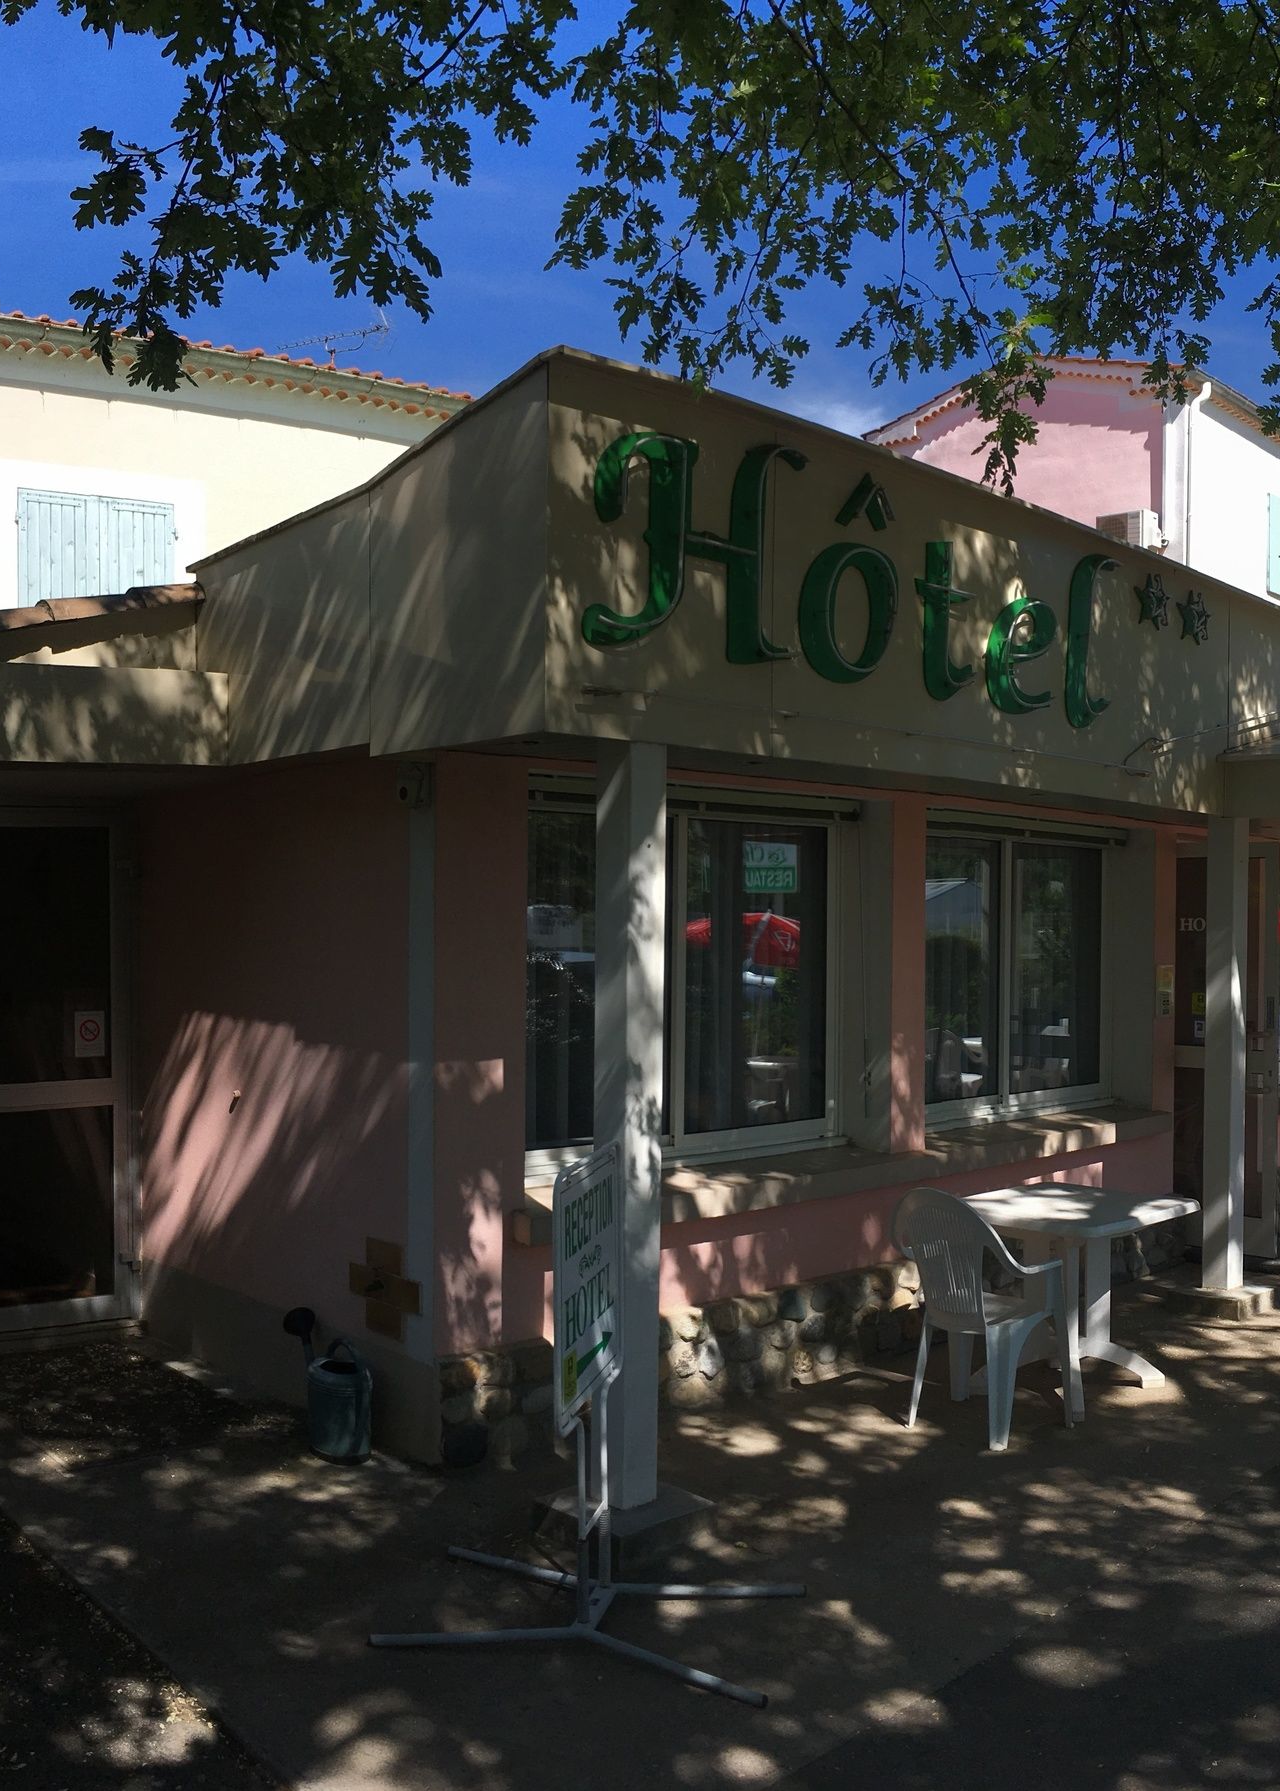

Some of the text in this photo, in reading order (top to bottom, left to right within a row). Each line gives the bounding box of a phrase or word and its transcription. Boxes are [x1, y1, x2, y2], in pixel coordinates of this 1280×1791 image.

[581, 431, 1122, 730] Hôtel
[564, 1174, 614, 1261] RECEPTION
[564, 1263, 615, 1350] HOTEL
